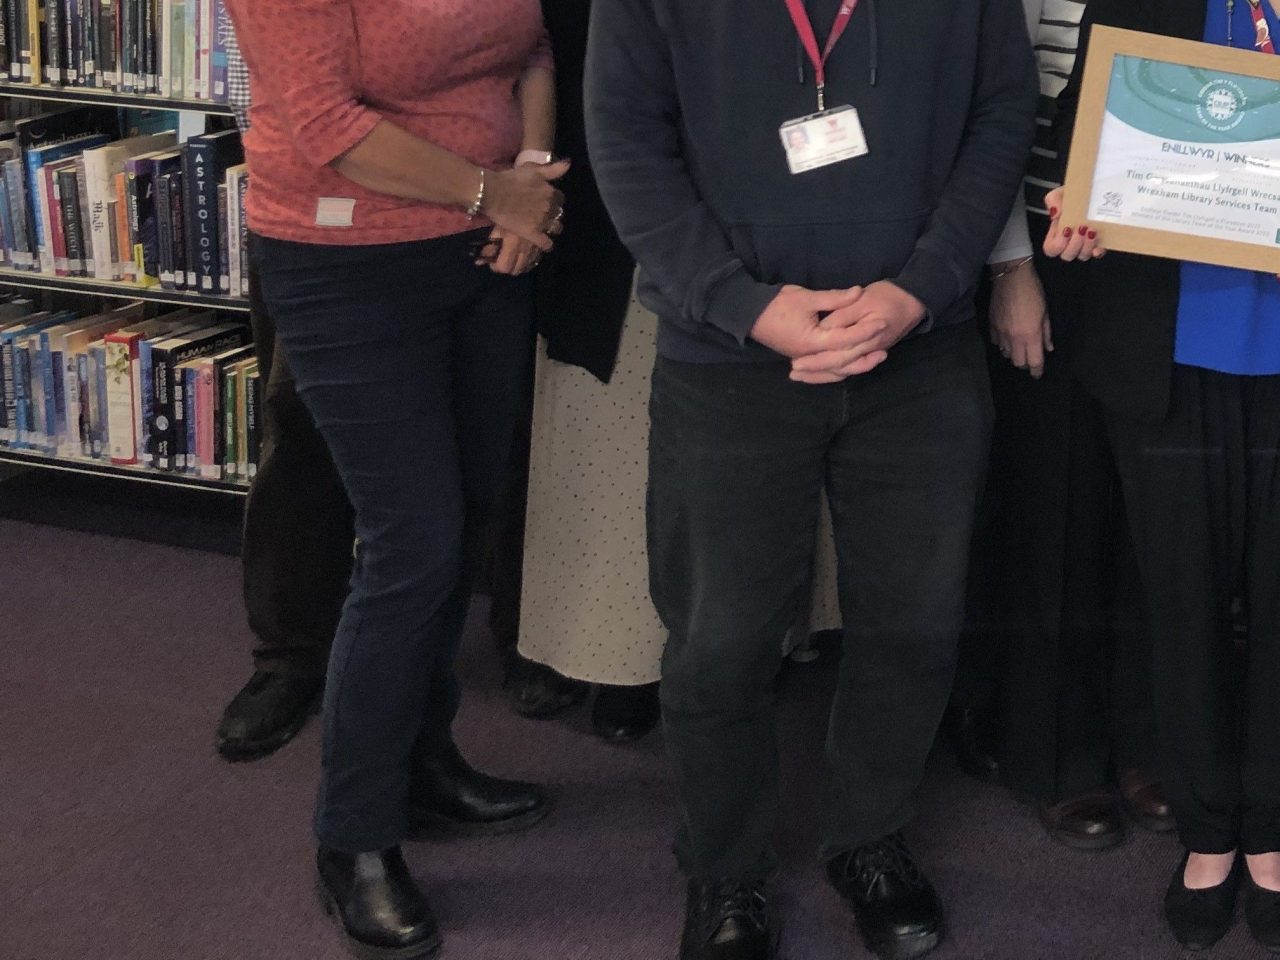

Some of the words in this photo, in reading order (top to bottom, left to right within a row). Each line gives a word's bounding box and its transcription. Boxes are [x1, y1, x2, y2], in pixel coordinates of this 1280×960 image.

[1161, 142, 1215, 159] ENILLWYR
[1126, 169, 1143, 180] Tim
[131, 195, 139, 232] Astrology
[195, 153, 212, 275] ASTROLOGY
[1182, 192, 1213, 206] Library
[1215, 197, 1251, 210] Services
[1254, 203, 1278, 214] Team
